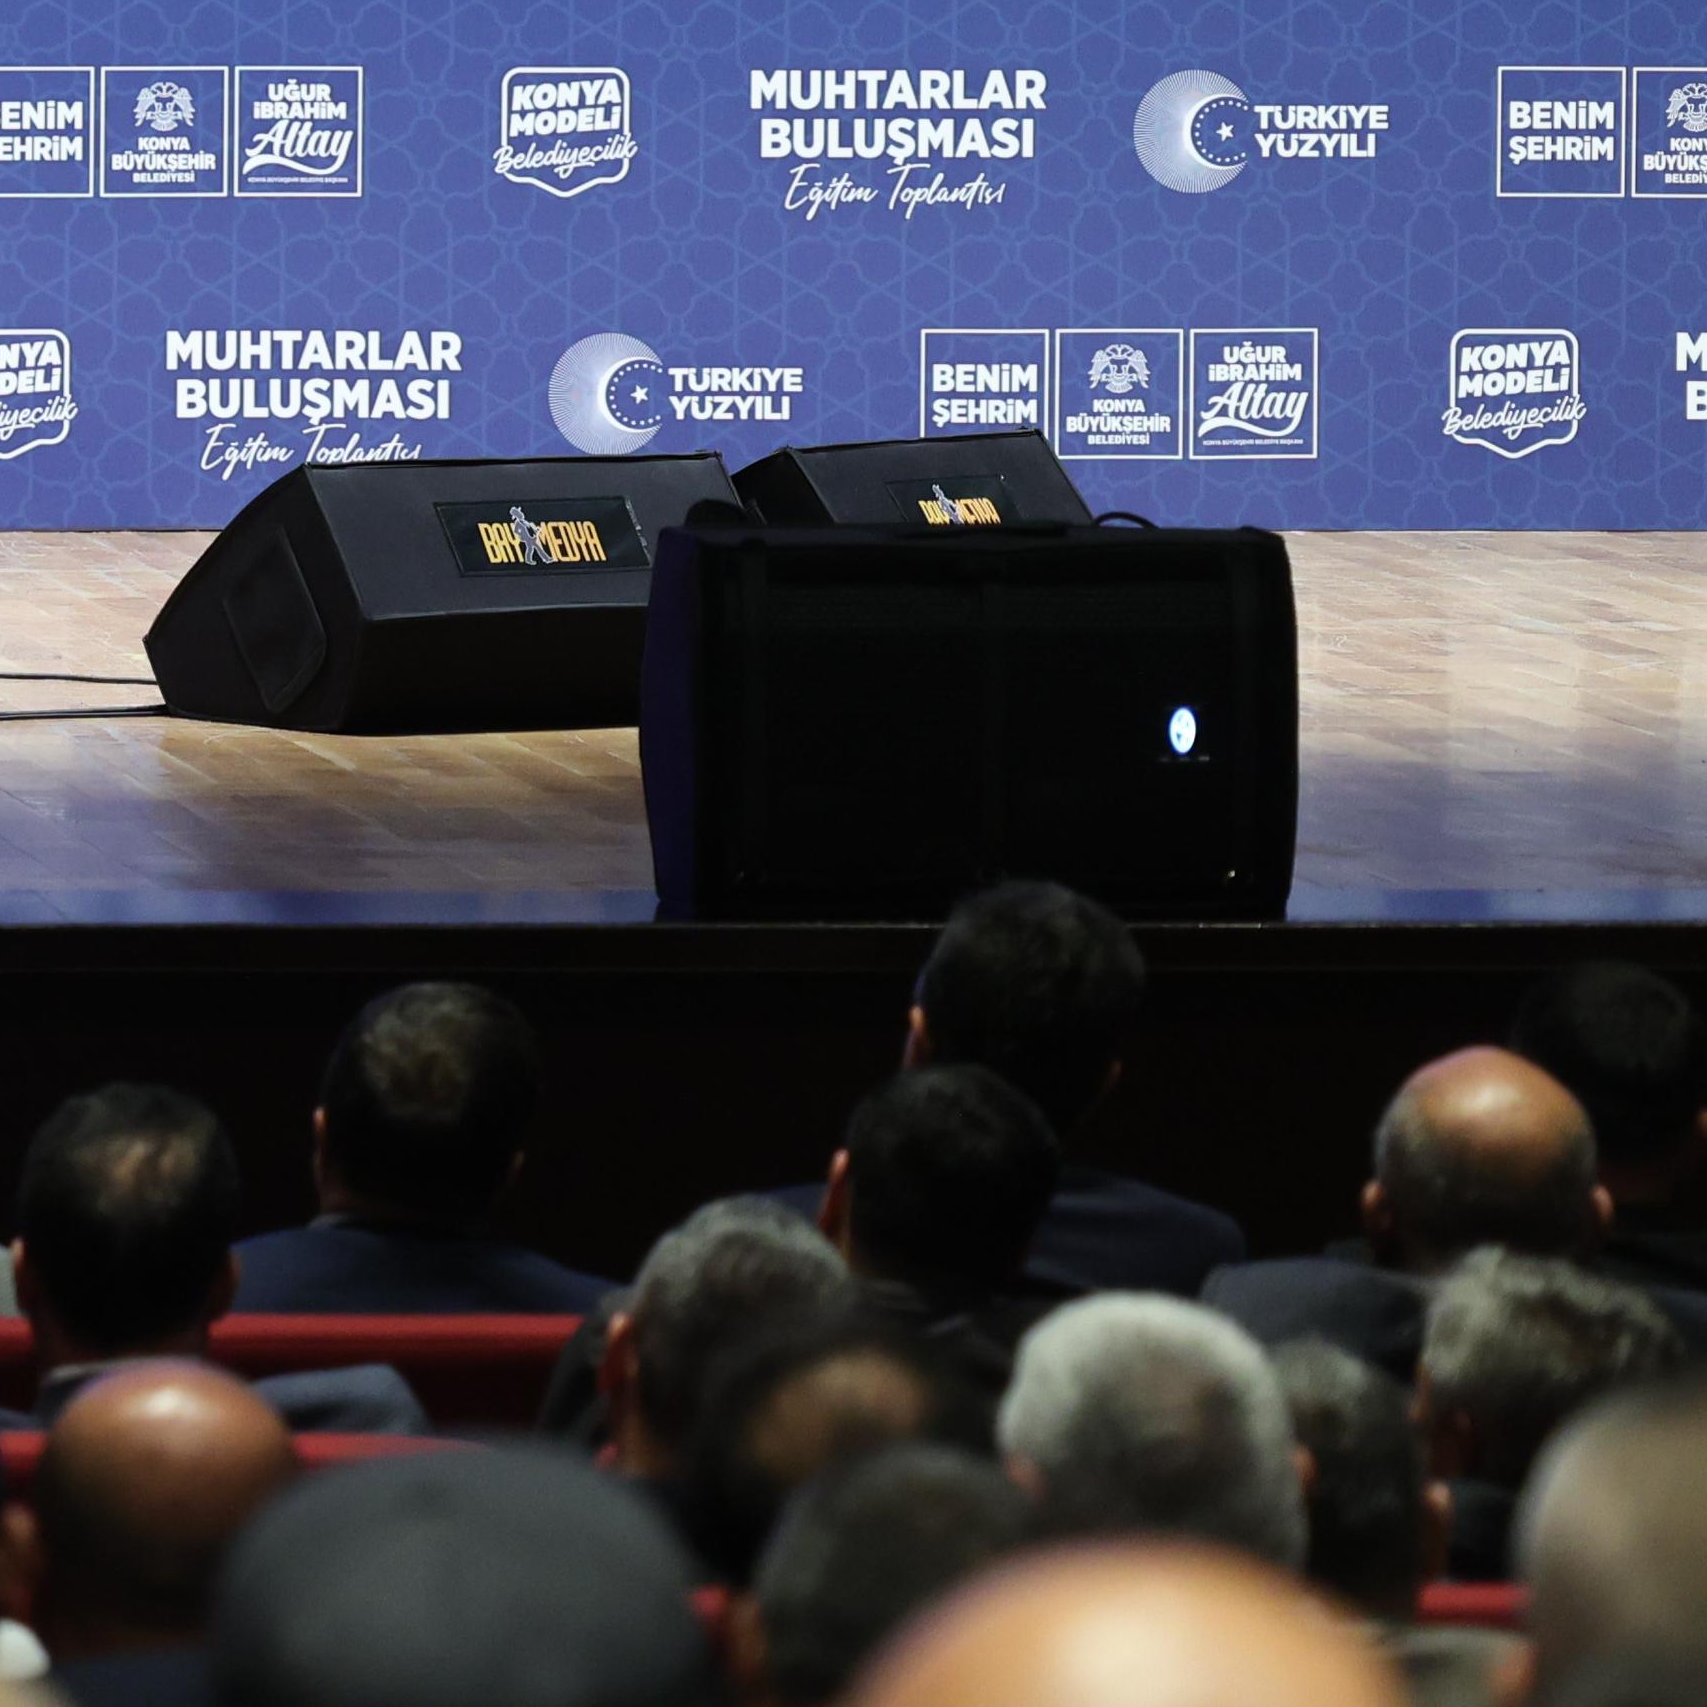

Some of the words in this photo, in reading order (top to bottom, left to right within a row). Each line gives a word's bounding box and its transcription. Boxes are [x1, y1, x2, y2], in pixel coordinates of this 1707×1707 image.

[511, 79, 622, 111] KONYA
[751, 70, 1044, 111] MUHTARLAR
[509, 106, 622, 137] MODELİ
[494, 132, 639, 179] Belediyecilik
[761, 119, 1033, 167] BULUŞMASI
[786, 163, 878, 222] Eğitim
[887, 163, 1006, 221] Toplantısı
[1222, 342, 1285, 364] UĞUR
[1459, 341, 1570, 373] KONYA
[933, 362, 1038, 392] BENİM
[1457, 368, 1570, 399] MODELİ
[933, 397, 1038, 427] ŞEHRİM
[1093, 398, 1145, 413] KONYA
[1197, 382, 1308, 438] Altay
[1442, 394, 1587, 441] Belediyecilik
[1066, 412, 1172, 435] BÜYÜKŞEHİR
[1087, 432, 1150, 445] BELEDİYESİ
